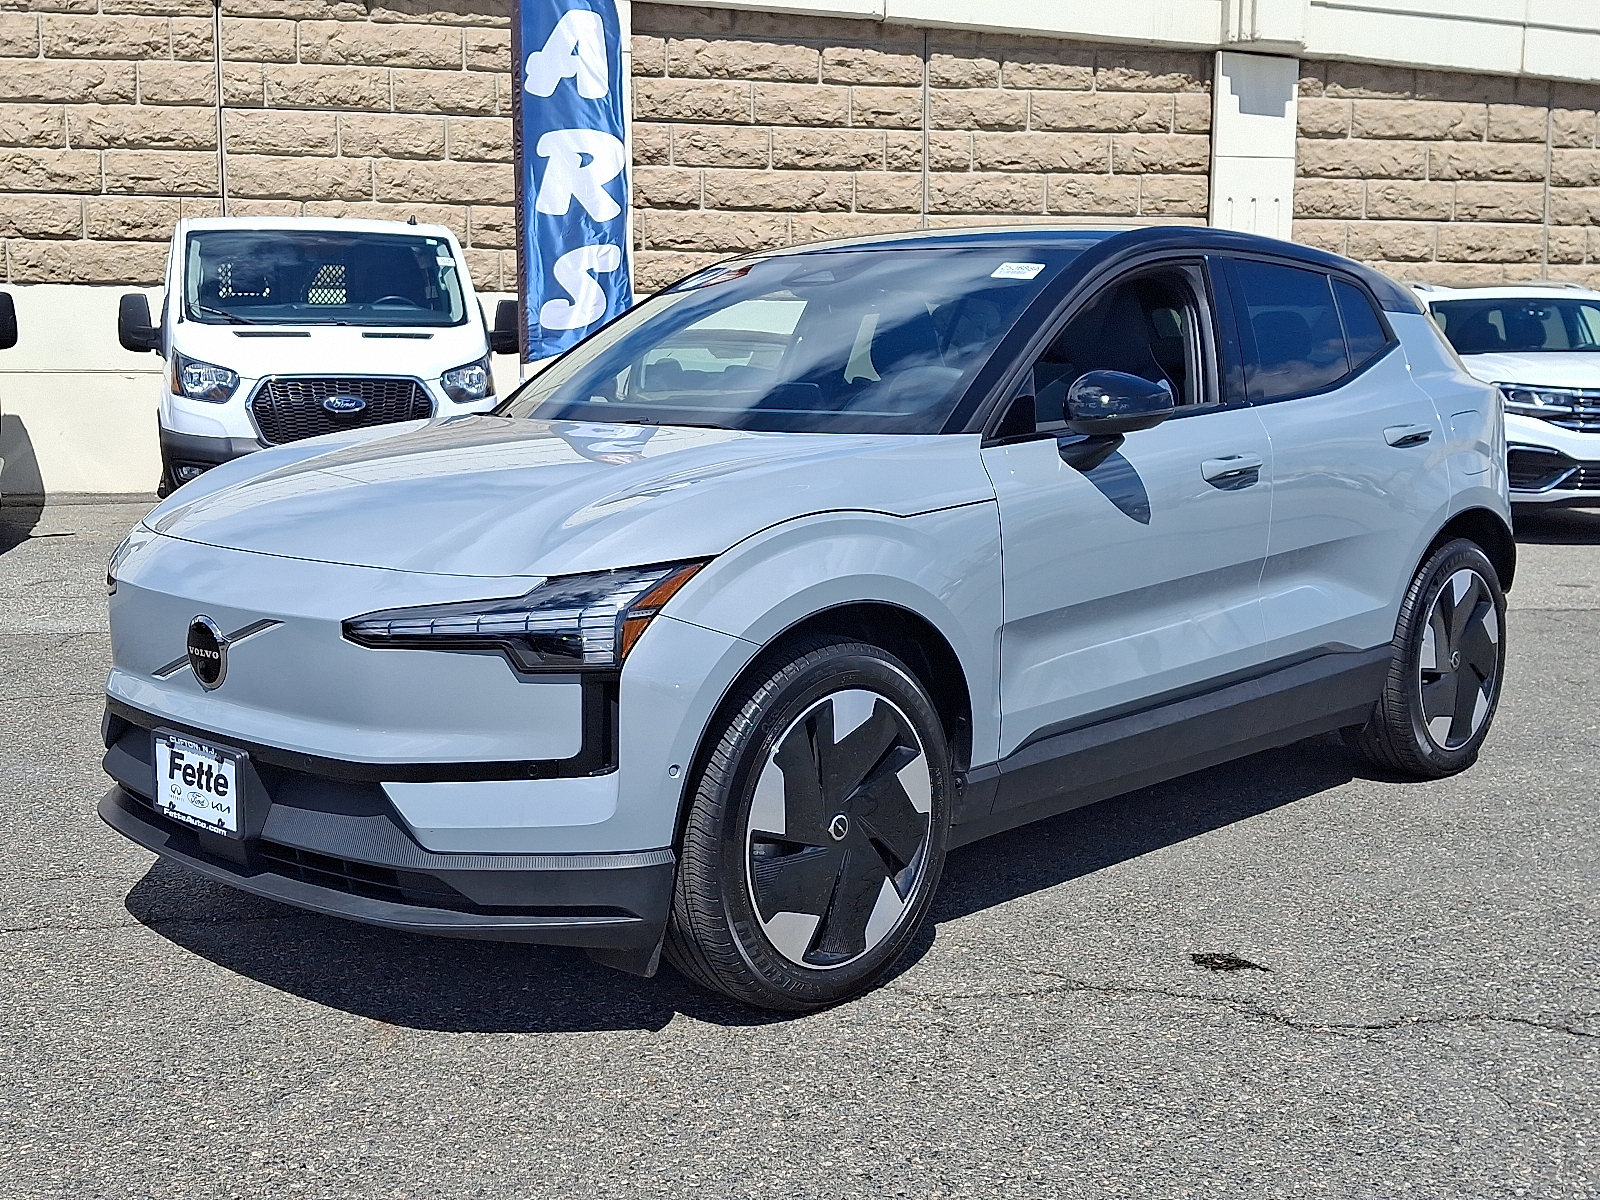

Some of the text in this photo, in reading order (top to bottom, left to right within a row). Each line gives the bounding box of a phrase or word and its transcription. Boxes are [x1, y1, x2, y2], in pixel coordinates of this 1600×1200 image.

[524, 9, 626, 330] ARS
[188, 645, 220, 660] VOLVO
[169, 750, 229, 797] Fette
[163, 807, 228, 837] FetteAuto.com
